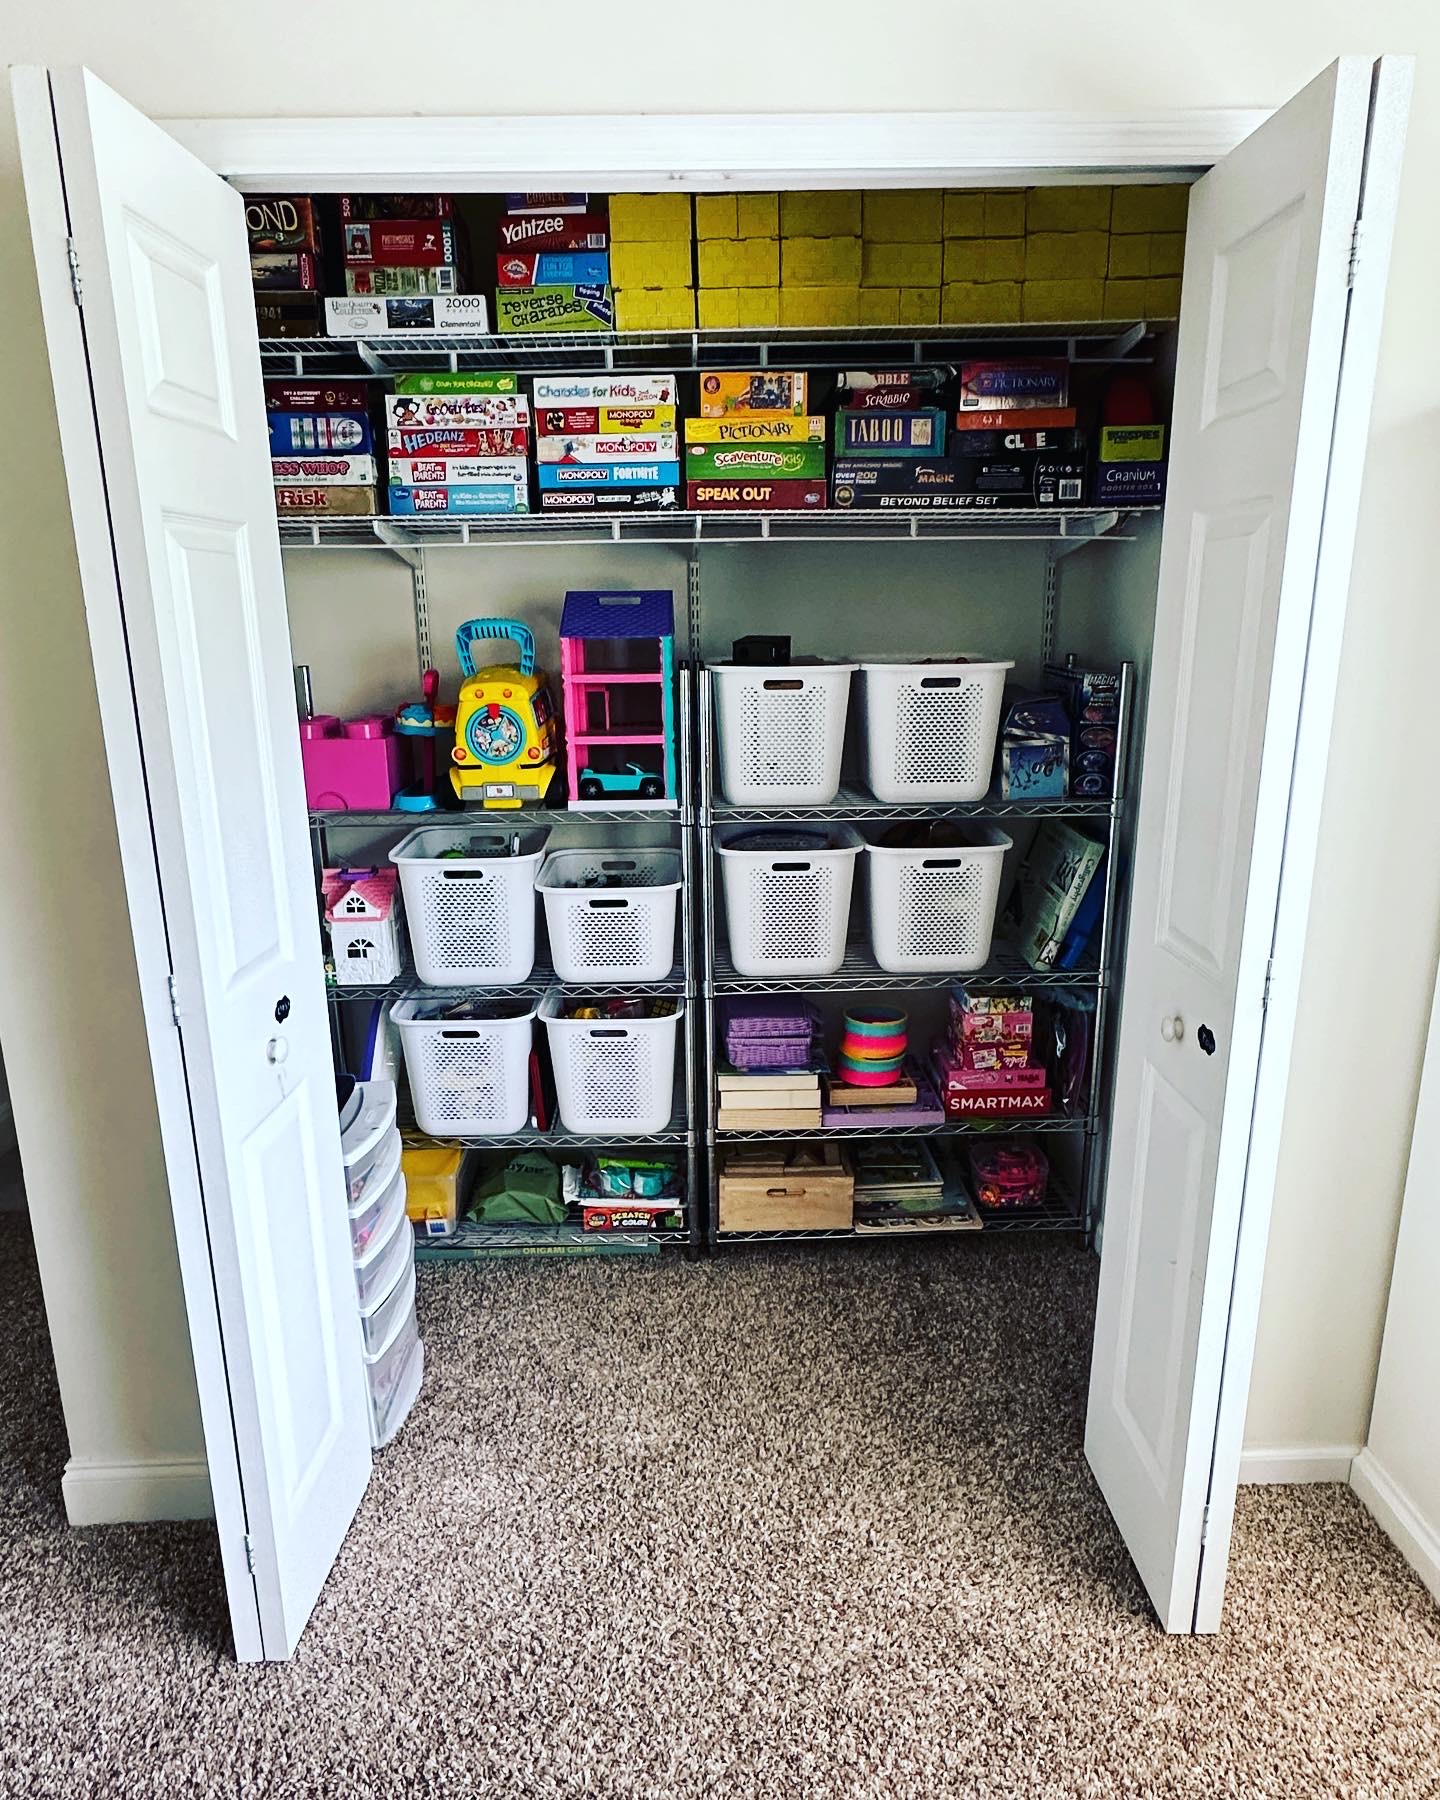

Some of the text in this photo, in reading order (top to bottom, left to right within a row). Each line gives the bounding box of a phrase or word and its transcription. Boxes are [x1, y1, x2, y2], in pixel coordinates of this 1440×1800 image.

[502, 217, 564, 245] Yahtzee
[445, 298, 481, 308] 2000
[502, 294, 563, 315] reverse
[440, 321, 481, 329] Clementoni
[994, 376, 1056, 388] PICTIONARY
[538, 384, 636, 397] Charades for Kids
[608, 410, 655, 419] MONOPOLY
[719, 422, 794, 440] PICTIONARY
[850, 419, 903, 442] TABOO
[403, 431, 465, 454] HEDBANZ
[1004, 432, 1046, 449] CLE
[301, 461, 350, 475] WHO?
[418, 462, 436, 472] BEAT
[560, 466, 658, 480] MONOPOLY FORTNITE
[413, 471, 445, 480] PARENTS
[918, 474, 955, 483] MAGIC
[279, 489, 327, 506] Risk
[420, 490, 437, 499] BEAT
[545, 495, 593, 504] MONOPOLY
[697, 487, 772, 501] SPEAK OUT
[415, 498, 447, 509] PARENTS
[880, 496, 998, 506] BEYOND BELIEF SET
[1088, 675, 1116, 686] MAGIC
[1071, 858, 1095, 902] Calligraphy
[950, 1096, 1045, 1110] SMARTMAX
[611, 1211, 651, 1221] SCRATCH
